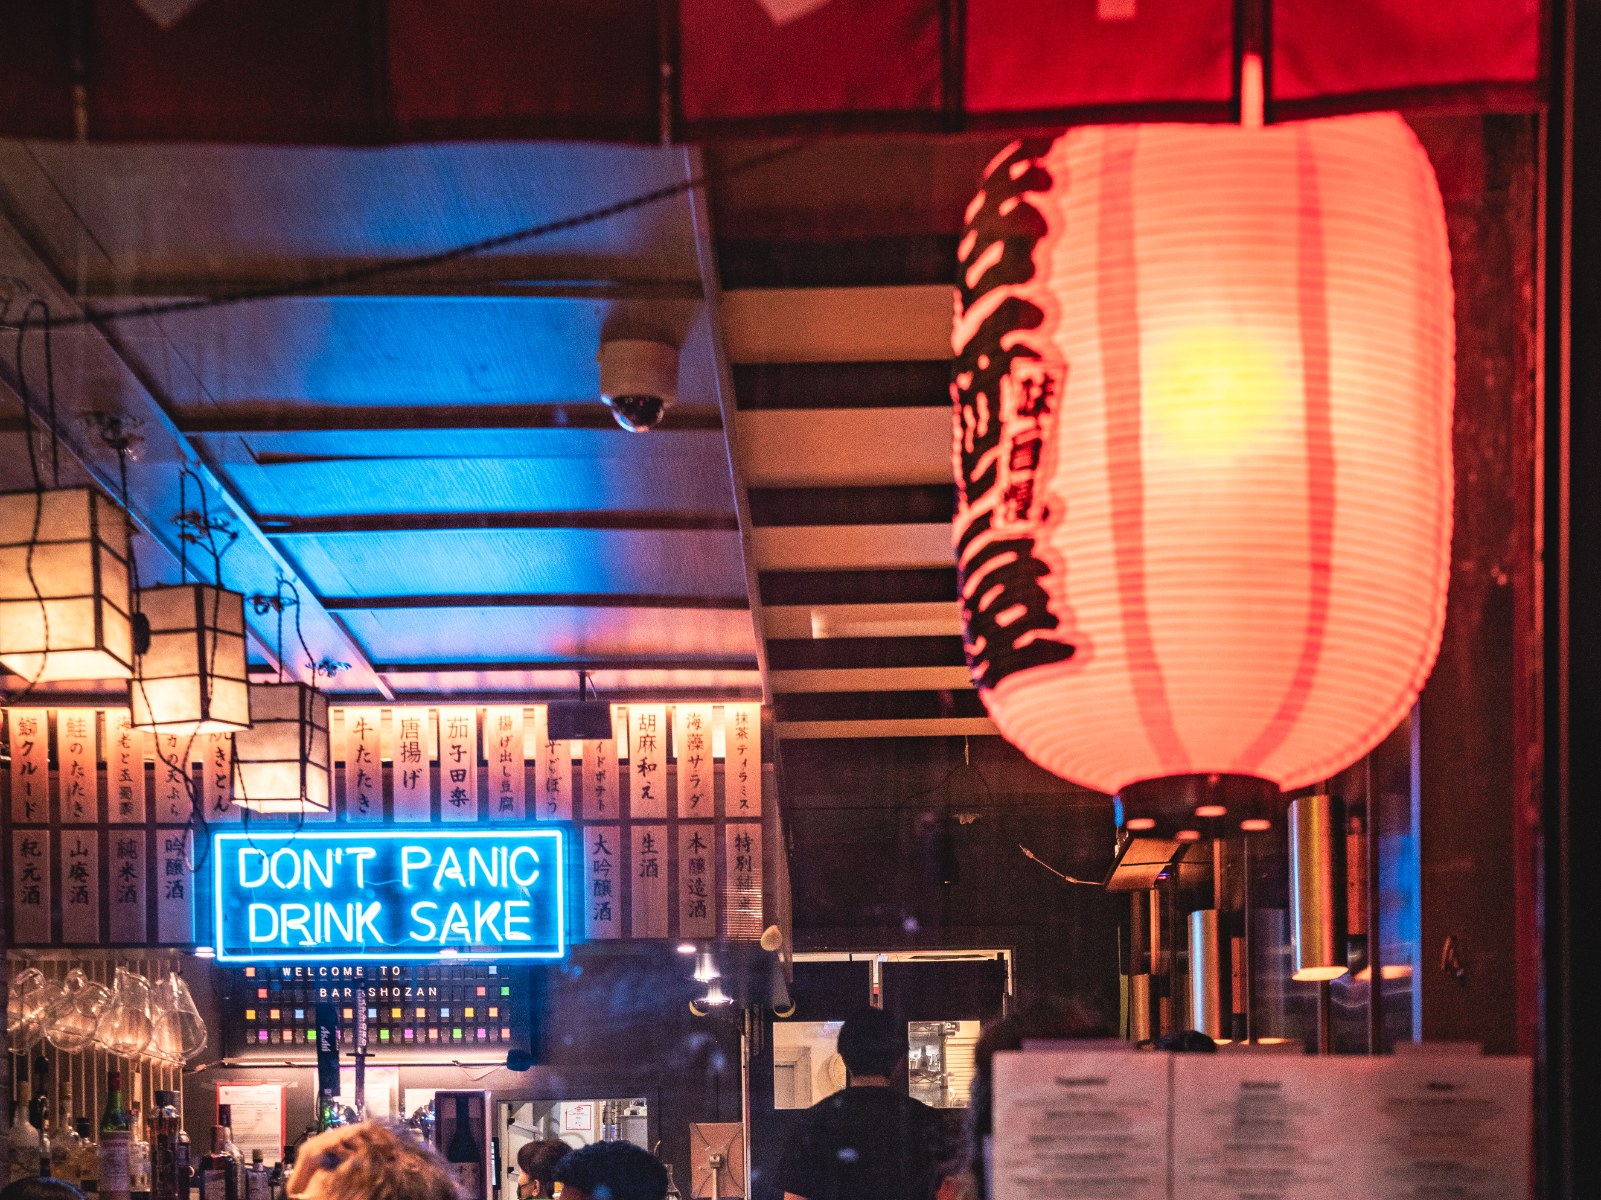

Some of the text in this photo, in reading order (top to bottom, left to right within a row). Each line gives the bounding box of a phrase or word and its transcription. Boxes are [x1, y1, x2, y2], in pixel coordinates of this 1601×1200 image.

[165, 734, 182, 817] カの天ぷら
[352, 716, 374, 814] 牛たたき
[399, 717, 423, 790] 唐揚げ
[446, 715, 470, 808] 茄子田楽
[636, 713, 658, 800] 胡麻和え
[686, 711, 705, 810] 海藻サラダ
[735, 711, 750, 810] 抹茶ティラミス
[117, 838, 139, 904] 純米酒
[164, 837, 186, 900] 吟醸酒
[237, 846, 541, 890] DON'T PANIC
[592, 833, 613, 922] 大吟醸酒
[639, 832, 660, 879] 生酒
[687, 831, 708, 919] 本醸造酒
[249, 900, 532, 945] DRINK SAKE
[282, 966, 401, 977] WELCOME TO
[319, 987, 438, 998] BAR SHOZAN
[320, 1025, 331, 1052] Asahi
